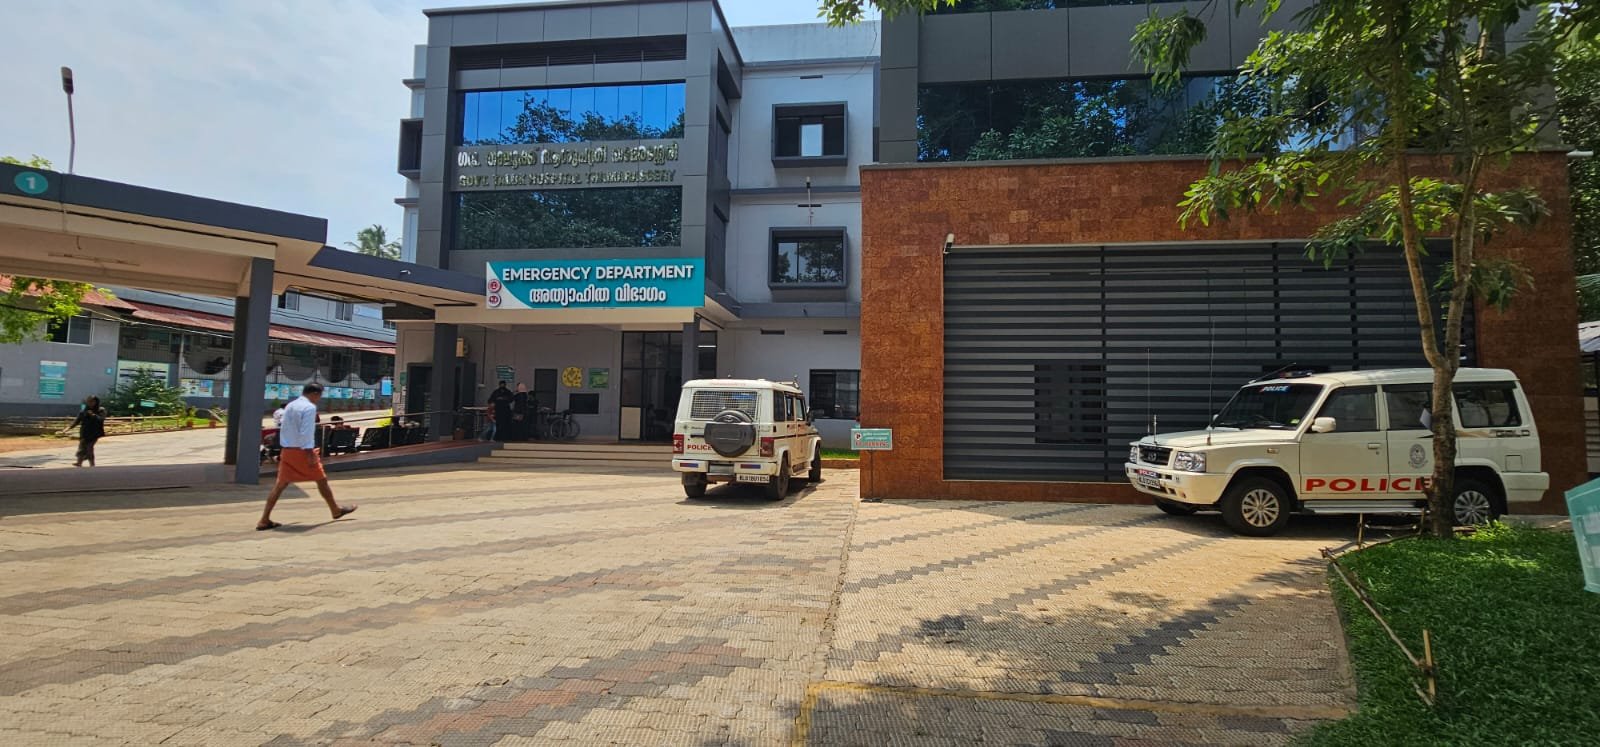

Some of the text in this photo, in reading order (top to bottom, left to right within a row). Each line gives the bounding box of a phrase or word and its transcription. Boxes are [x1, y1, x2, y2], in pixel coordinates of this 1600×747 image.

[25, 177, 36, 190] 1
[493, 173, 526, 186] TALUK
[528, 171, 582, 186] HOSPITAL
[502, 264, 694, 281] EMERGENCY DEPARTMENT
[529, 282, 667, 306] അത്യാഹിത വിഭാഗം
[1138, 469, 1158, 478] POLICE
